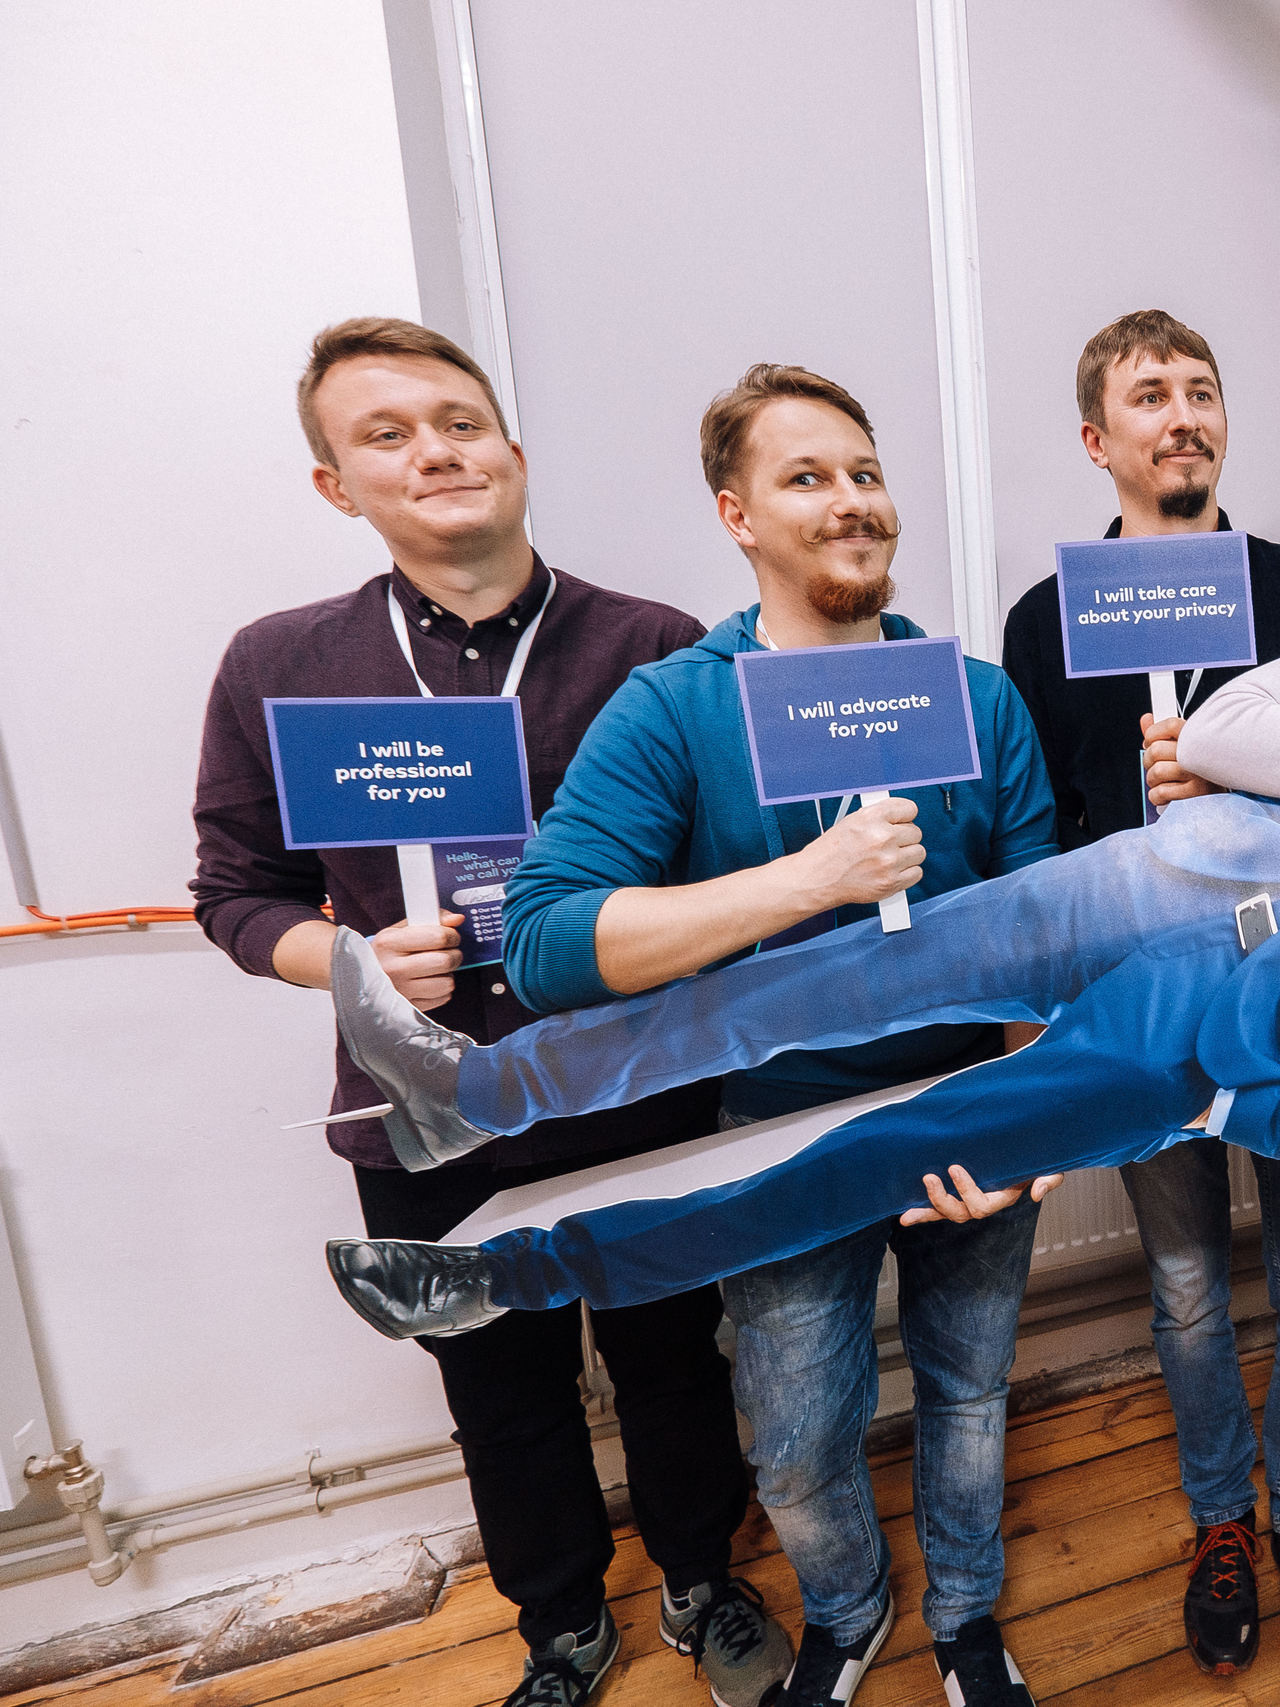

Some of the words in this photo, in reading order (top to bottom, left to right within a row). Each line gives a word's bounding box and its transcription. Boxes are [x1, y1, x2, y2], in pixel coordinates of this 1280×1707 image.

[1094, 589, 1101, 604] I
[1103, 586, 1134, 603] will
[1137, 584, 1177, 601] take
[1179, 585, 1217, 598] care
[1077, 608, 1130, 625] about
[1131, 607, 1171, 625] your
[1174, 601, 1237, 622] privacy
[787, 704, 795, 721] I
[799, 700, 835, 720] will
[839, 694, 931, 716] advocate
[828, 721, 859, 739] for
[862, 720, 899, 739] you
[359, 742, 367, 758] I
[370, 741, 412, 758] will
[416, 740, 444, 757] be
[335, 760, 472, 785] professional
[367, 784, 402, 801] for
[405, 787, 446, 803] you
[463, 859, 495, 871] what
[497, 856, 520, 866] can
[455, 873, 475, 882] we
[476, 868, 500, 879] call
[500, 867, 516, 877] yo
